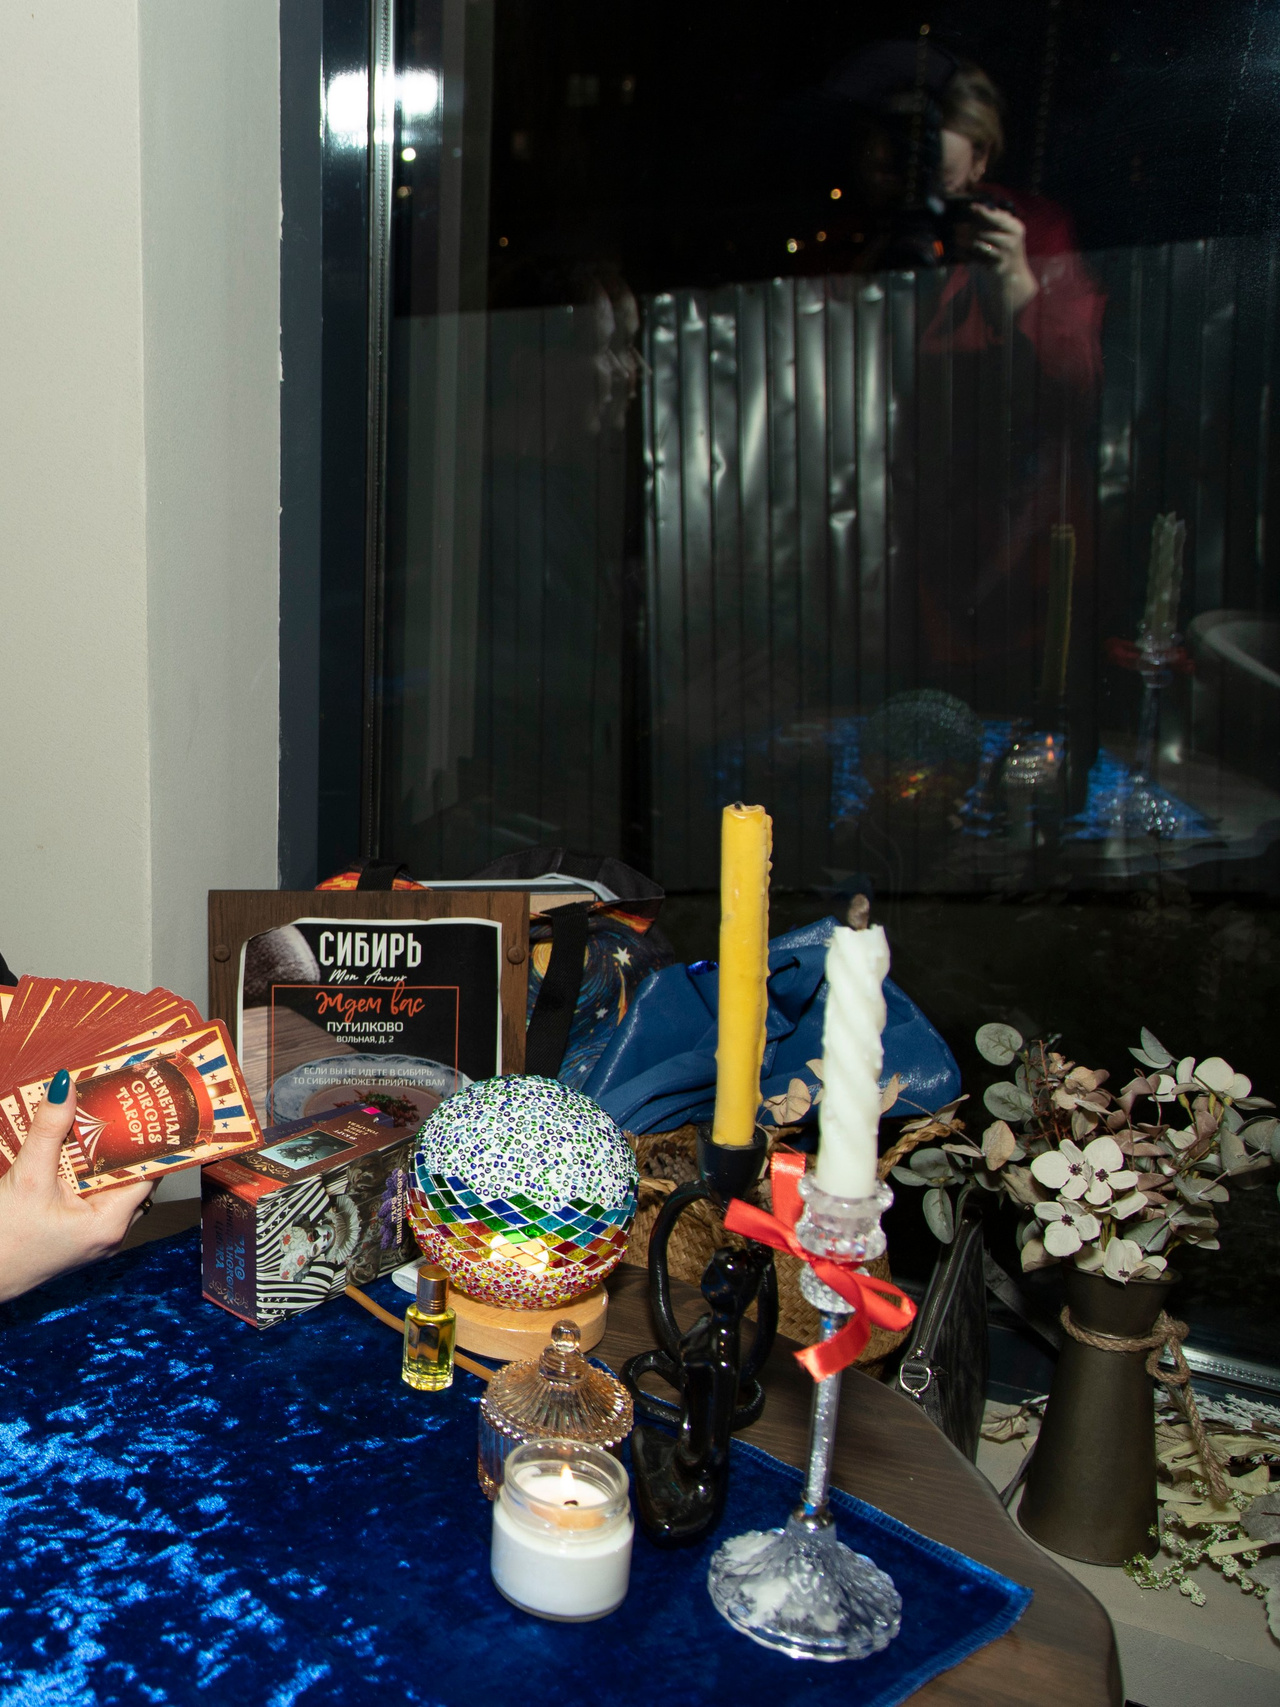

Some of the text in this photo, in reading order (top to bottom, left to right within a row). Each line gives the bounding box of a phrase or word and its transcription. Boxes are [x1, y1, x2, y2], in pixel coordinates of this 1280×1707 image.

[320, 931, 422, 968] СИБИРЬ
[328, 968, 407, 985] Mon Amour
[326, 1022, 404, 1033] ПУТИЛКОВО
[336, 1035, 395, 1044] ВОЛЬНАЯ, Д. 2
[304, 1067, 434, 1077] ЕСЛИ ВЫ НЕ ИДЕТЕ В СИБИРЬ,
[293, 1077, 446, 1087] ТО СИБИРЬ МОЖЕТ ПРИЙТИ К ВАМ
[131, 1080, 162, 1144] CIRCUS
[144, 1066, 180, 1145] VENETIAN
[115, 1086, 145, 1145] TAROT
